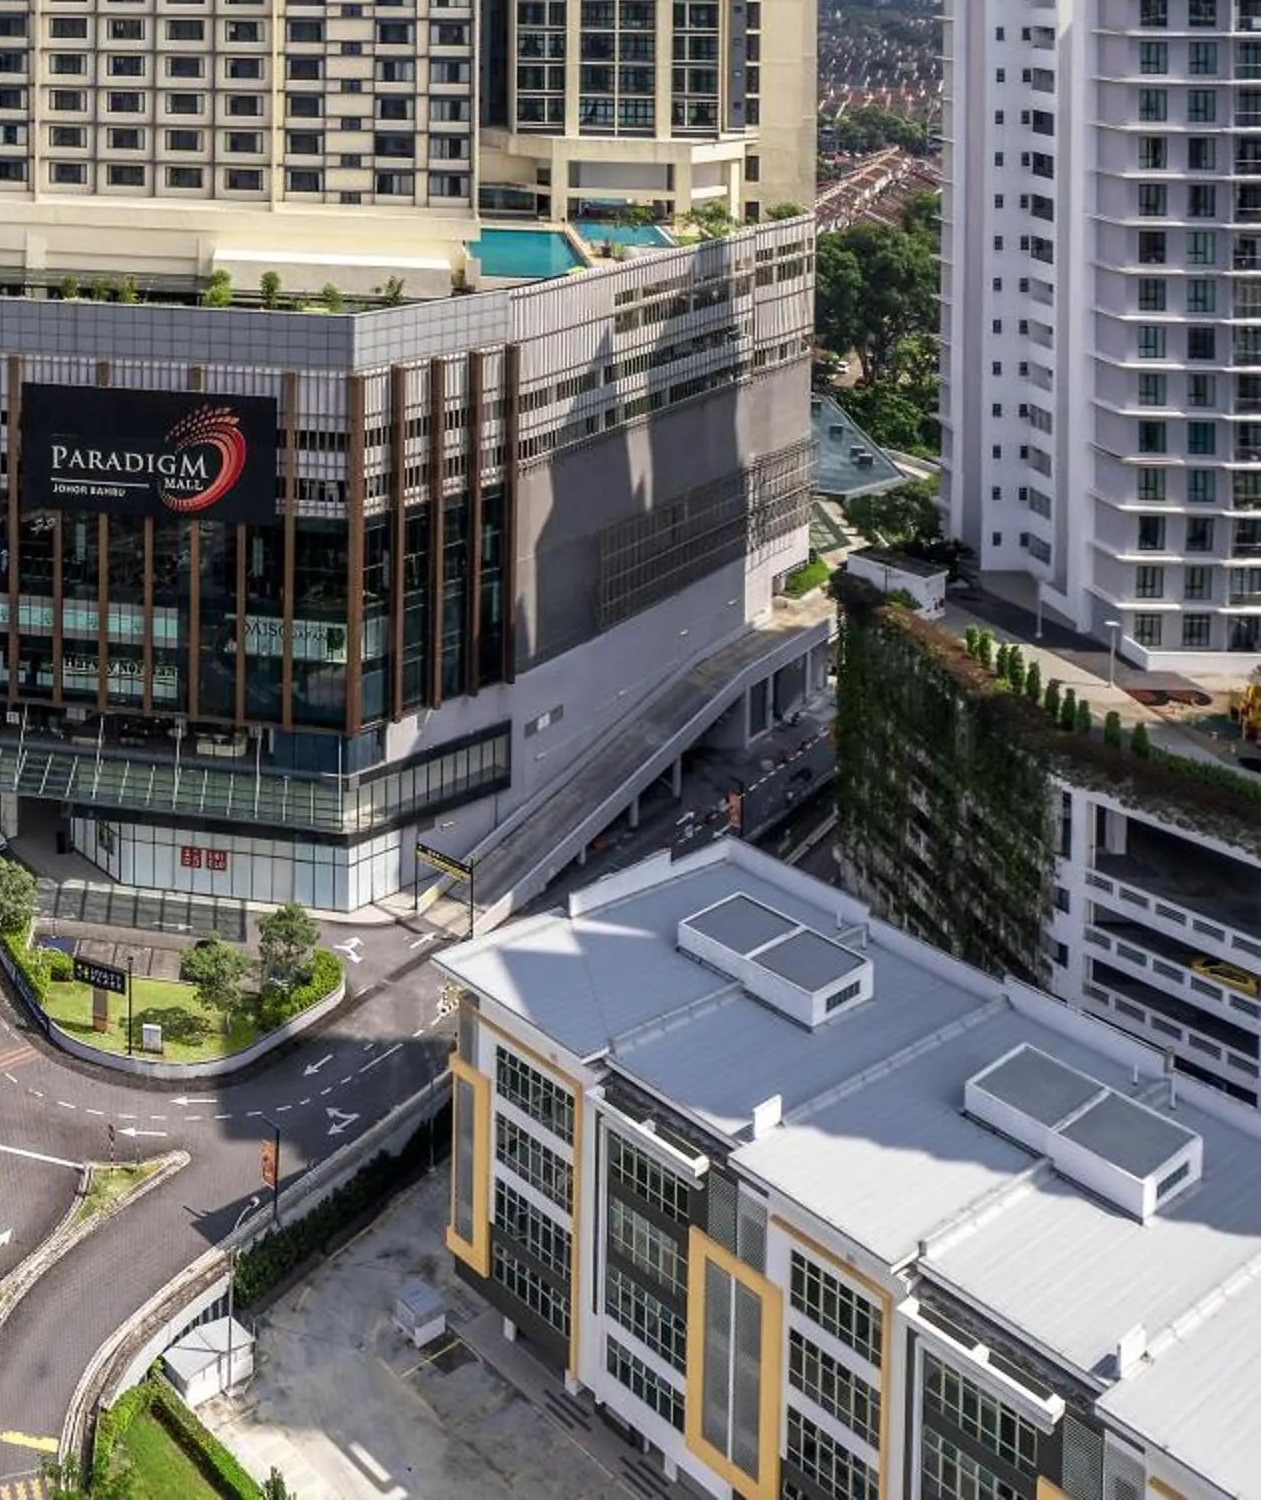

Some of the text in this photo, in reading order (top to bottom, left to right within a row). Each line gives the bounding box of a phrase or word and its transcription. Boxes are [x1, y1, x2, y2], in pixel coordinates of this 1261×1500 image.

[50, 444, 209, 479] PARADIGM
[52, 483, 88, 496] JOHOR
[164, 477, 204, 491] MALL
